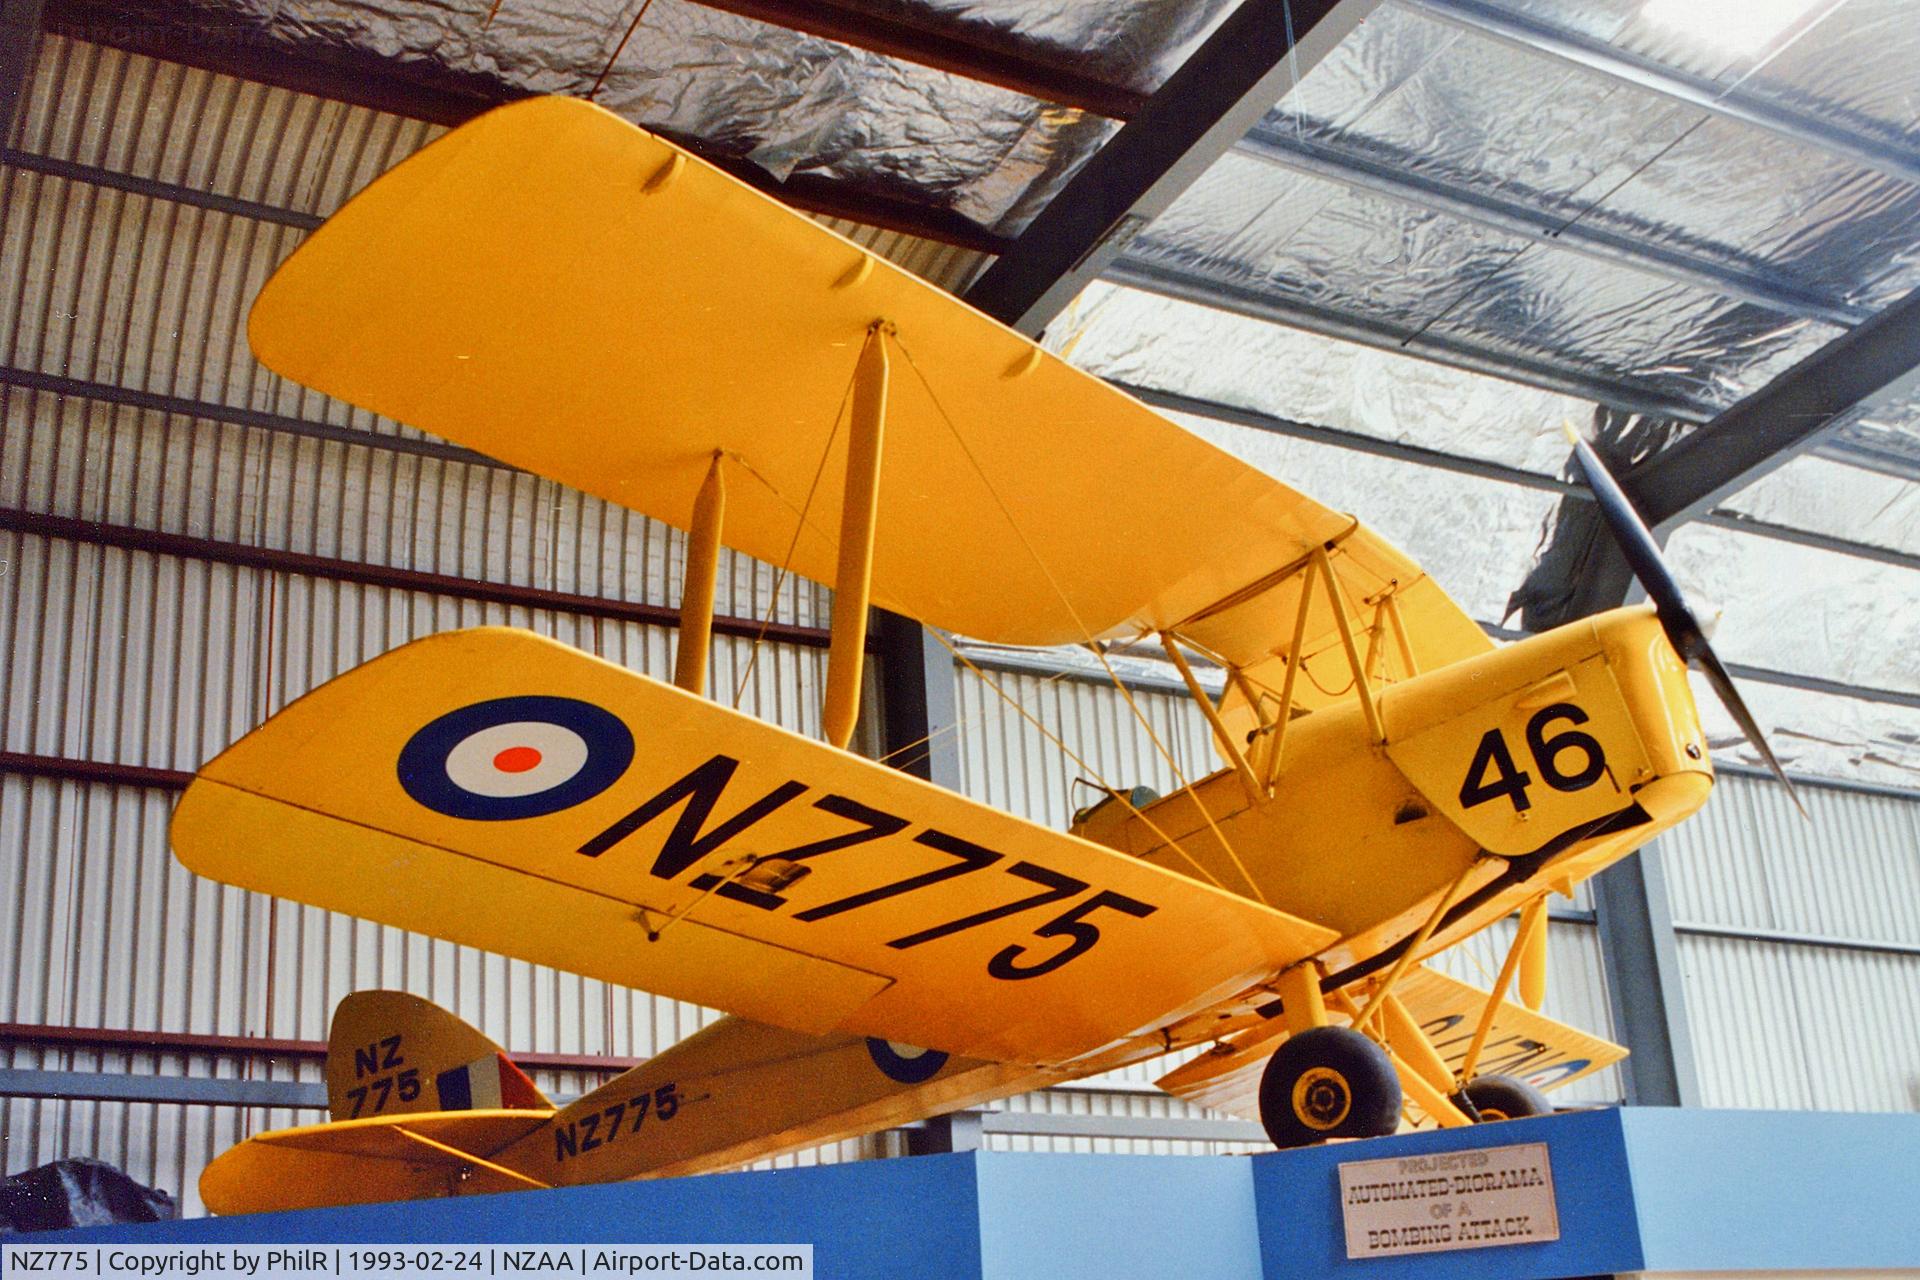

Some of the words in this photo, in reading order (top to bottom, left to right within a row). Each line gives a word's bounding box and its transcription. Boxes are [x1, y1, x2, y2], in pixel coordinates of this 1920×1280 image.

[1459, 703, 1606, 813] 46
[354, 1034, 404, 1079] NZ
[347, 1068, 421, 1120] 775
[554, 1082, 679, 1162] NZ775
[1399, 1152, 1489, 1175] PROJECTED
[1367, 1223, 1451, 1250] BOMBING
[1457, 1215, 1533, 1241] ATTACK
[1429, 1202, 1453, 1220] OF
[1457, 1200, 1472, 1218] A
